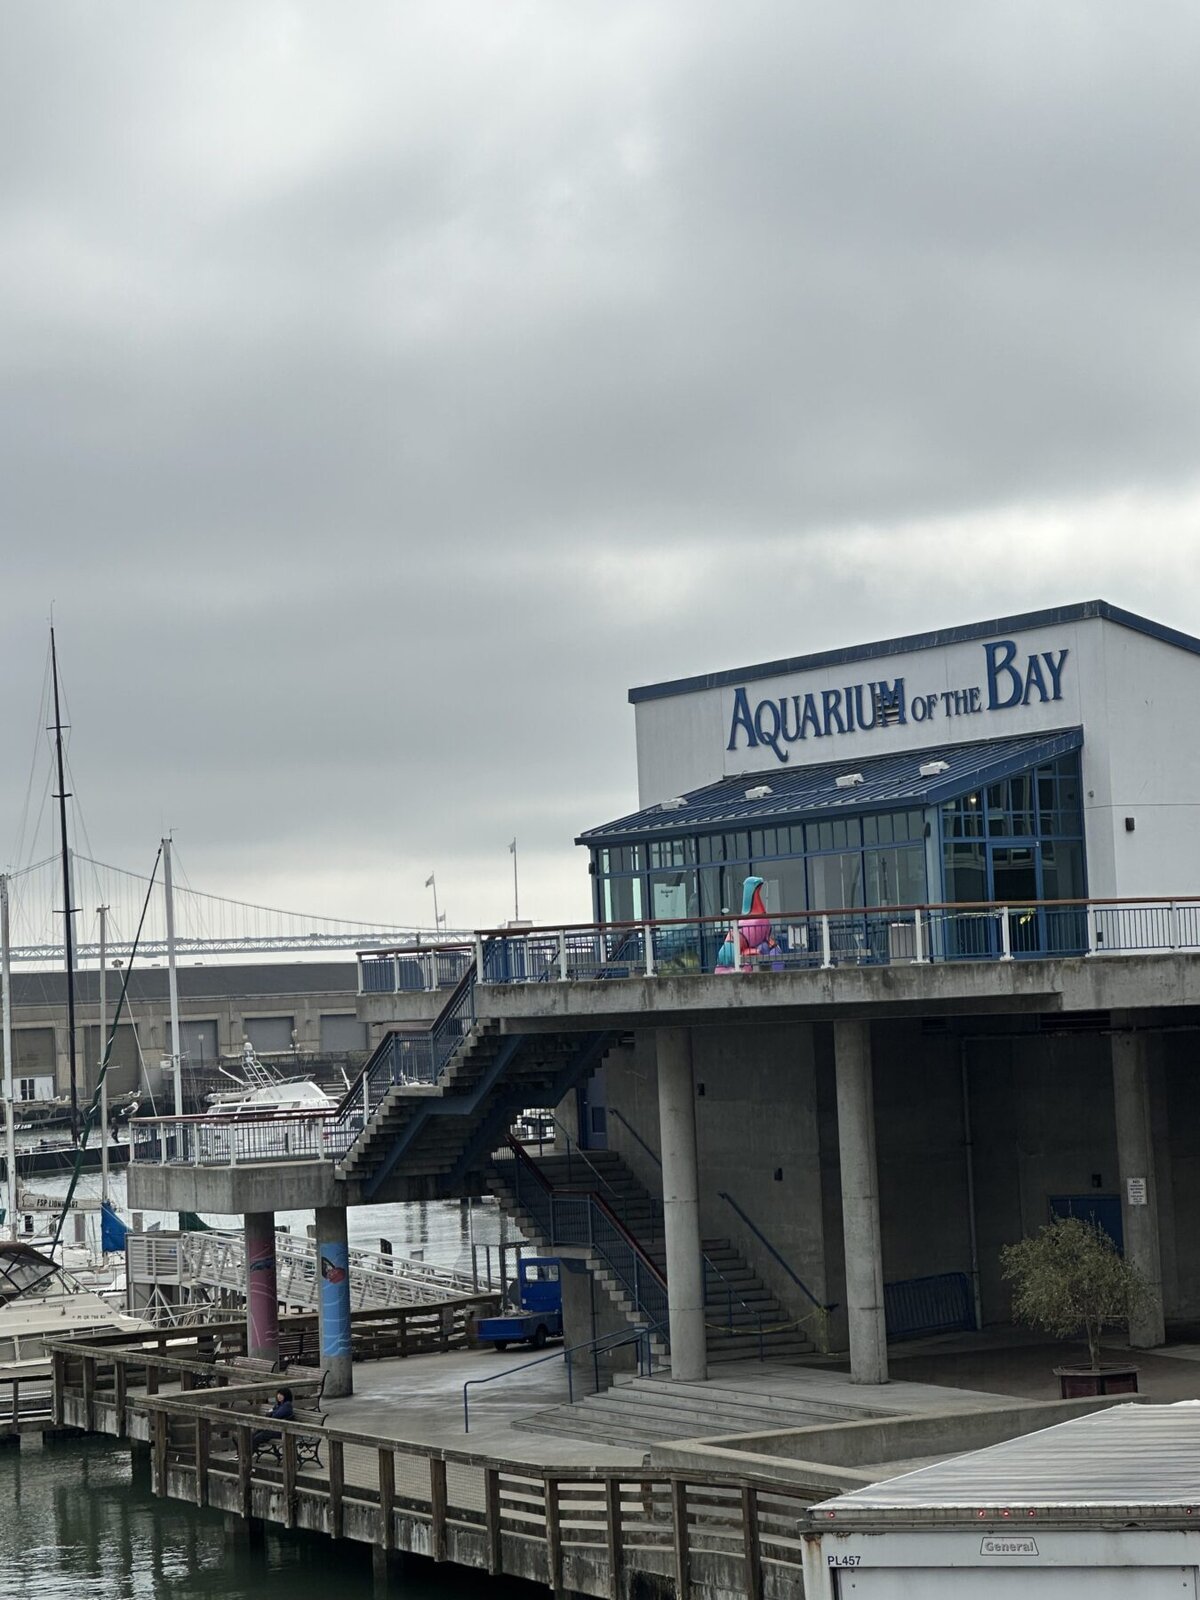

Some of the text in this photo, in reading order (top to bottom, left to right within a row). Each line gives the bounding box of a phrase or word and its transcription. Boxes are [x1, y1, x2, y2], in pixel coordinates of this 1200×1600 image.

[726, 640, 1069, 762] AQUARIUM OF THE BAY
[985, 1541, 1034, 1552] General
[827, 1555, 861, 1566] PL457
